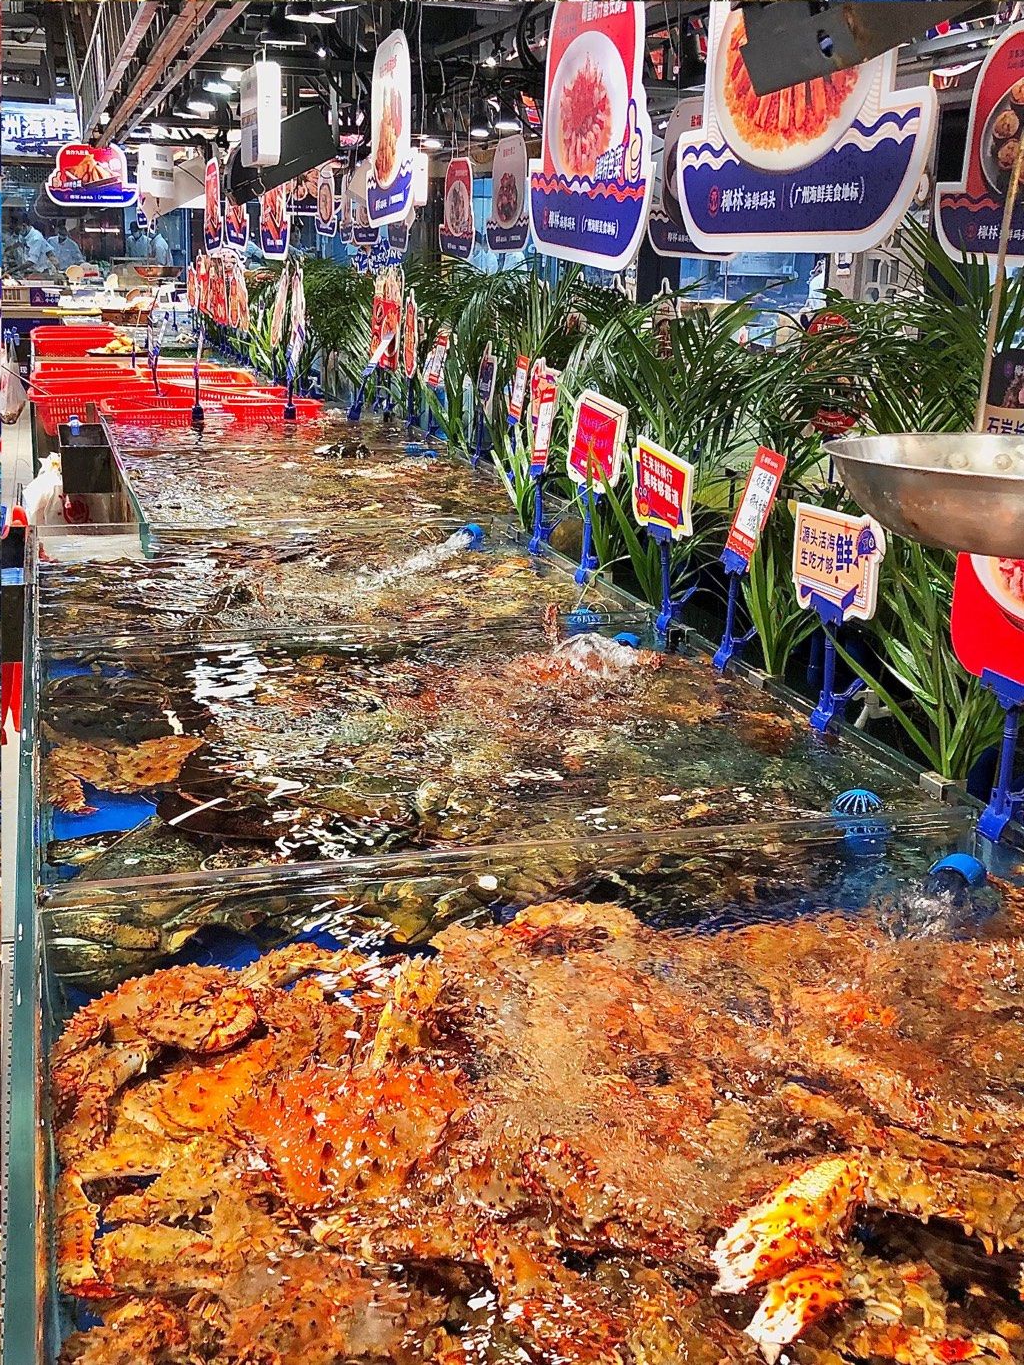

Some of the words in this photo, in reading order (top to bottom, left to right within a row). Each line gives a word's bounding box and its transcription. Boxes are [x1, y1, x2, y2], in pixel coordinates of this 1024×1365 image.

[743, 189, 776, 211] 海鲜码头
[793, 182, 860, 204] 广州海鲜美食地标
[800, 547, 834, 575] 生吃才够
[835, 532, 853, 574] 鲜
